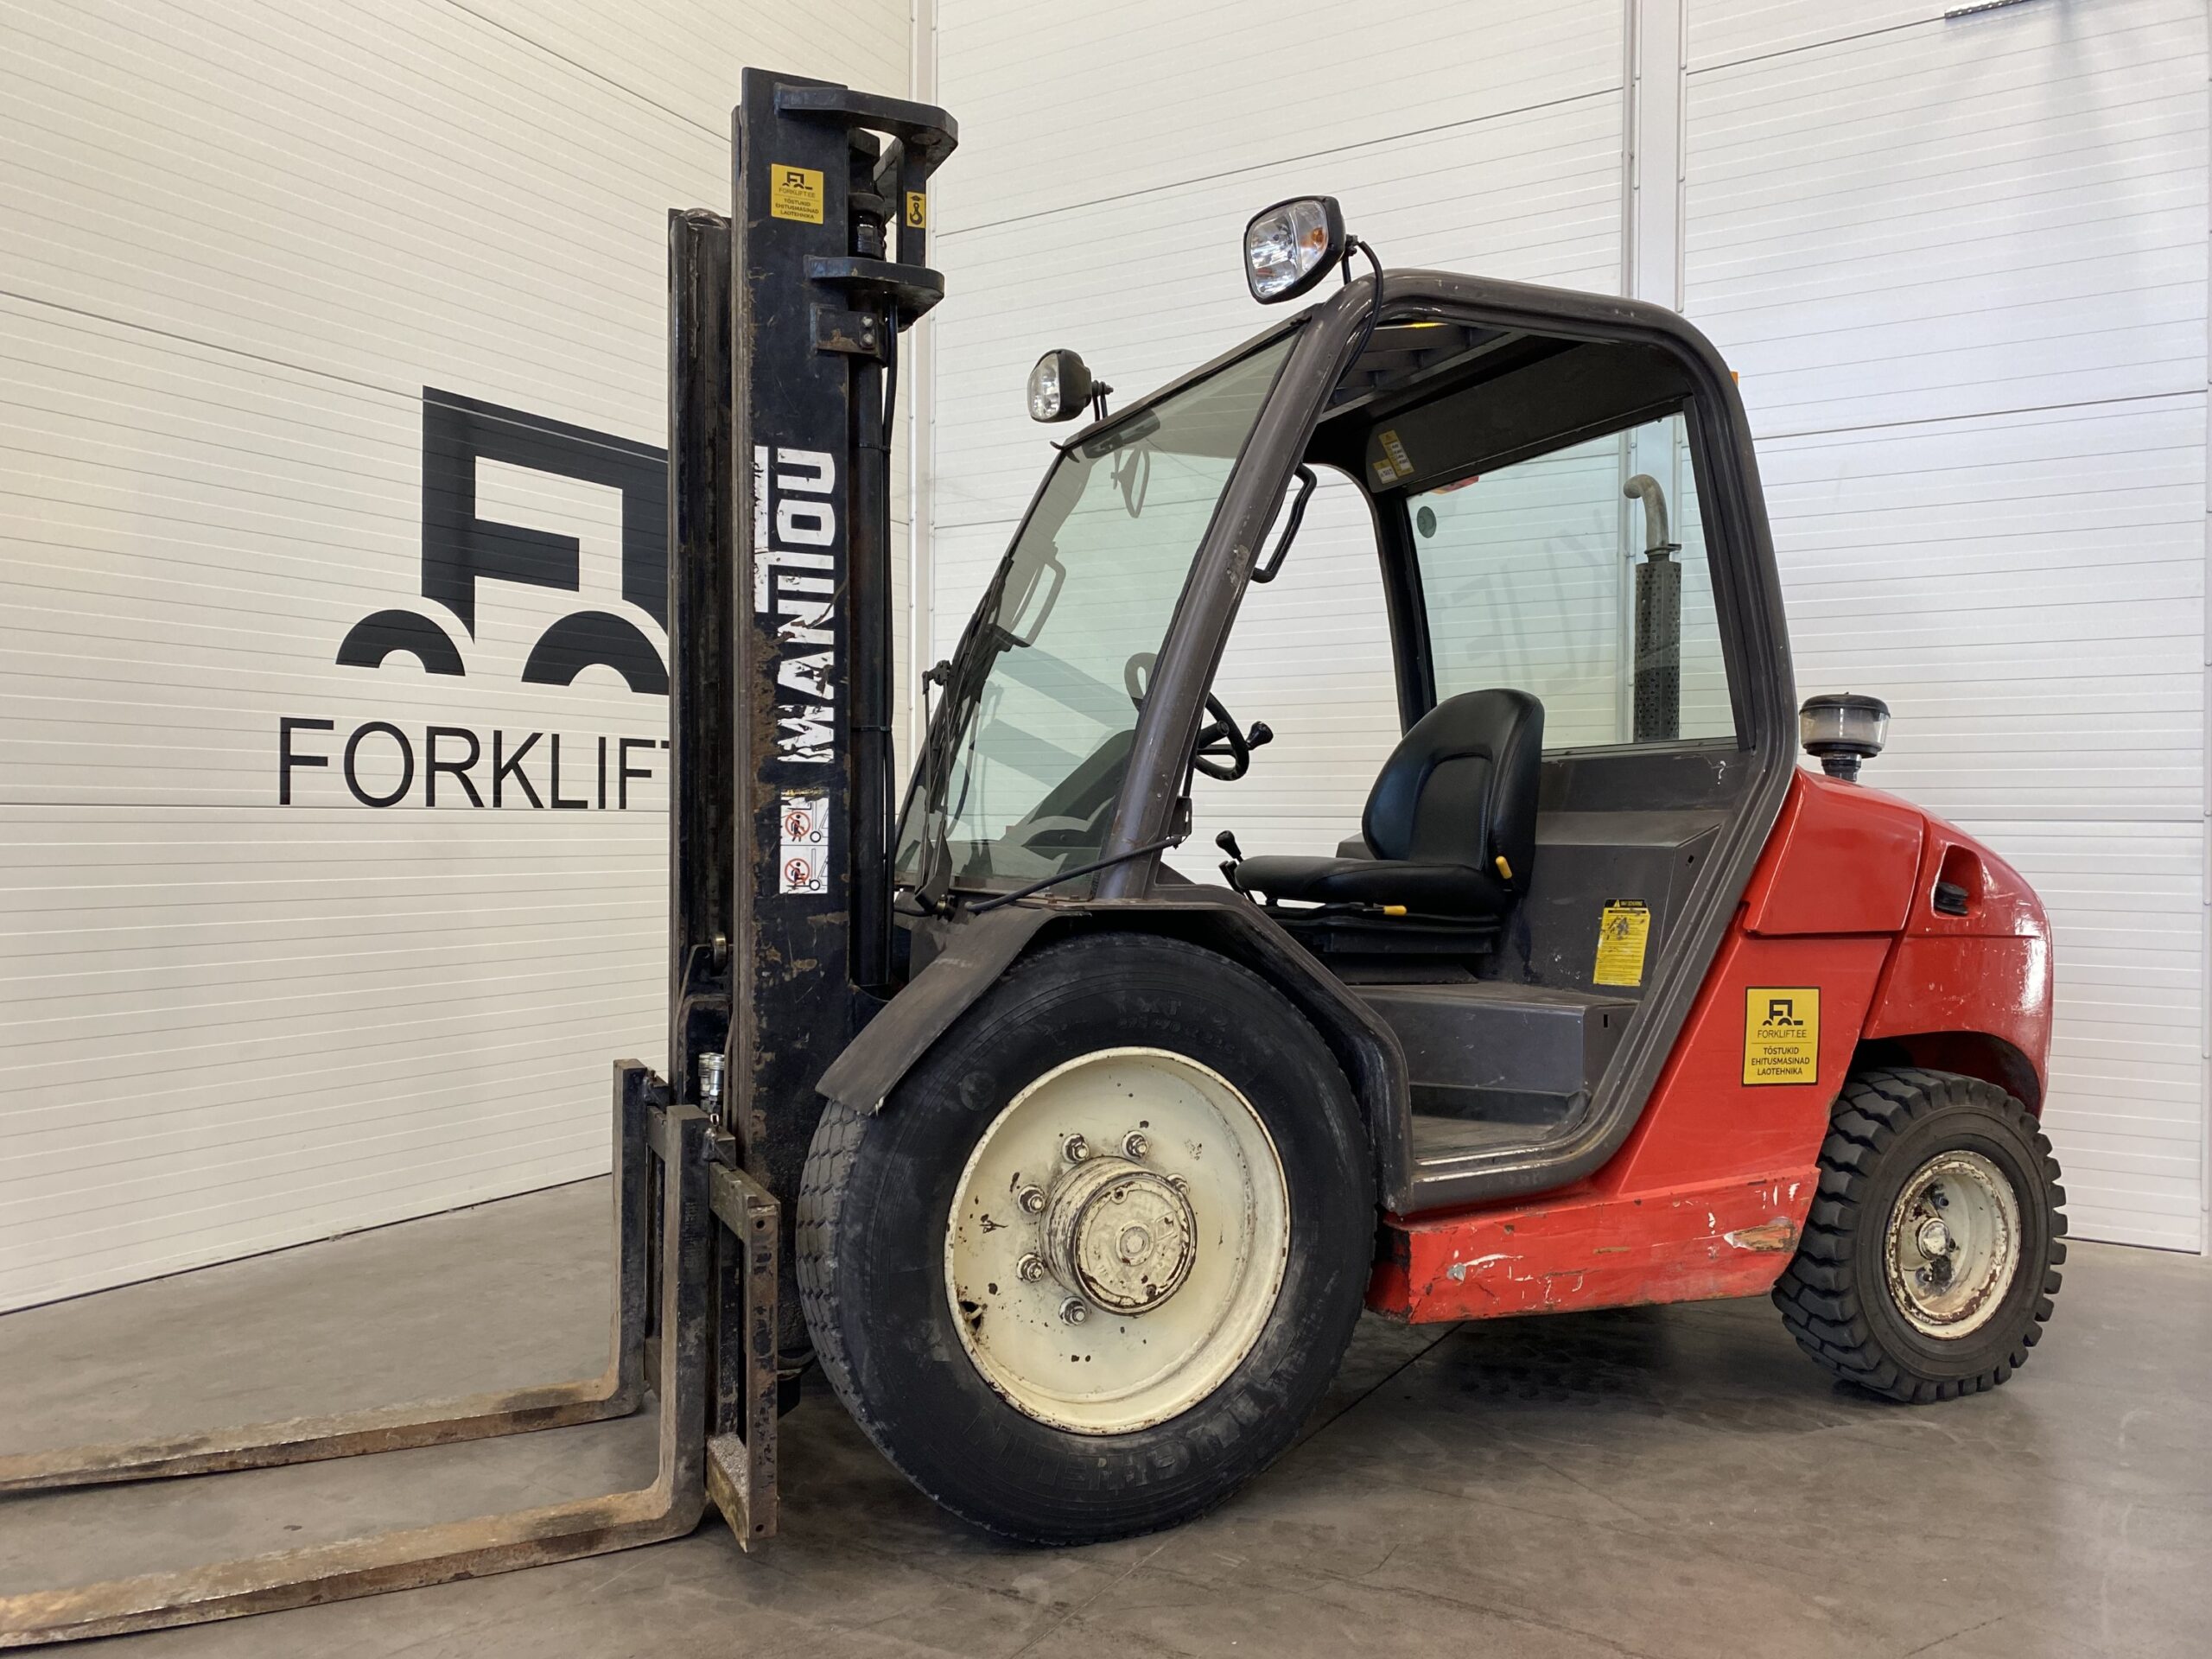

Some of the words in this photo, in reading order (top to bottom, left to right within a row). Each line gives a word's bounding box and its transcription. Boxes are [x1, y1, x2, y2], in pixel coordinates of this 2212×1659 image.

[754, 445, 836, 763] MANITOU
[279, 716, 670, 809] FORKLIF
[1757, 1029, 1808, 1039] FORKLIFT.EE
[1751, 1057, 1810, 1065] EHITUSMASINAD
[1757, 1066, 1803, 1076] LAOTEHNIKA
